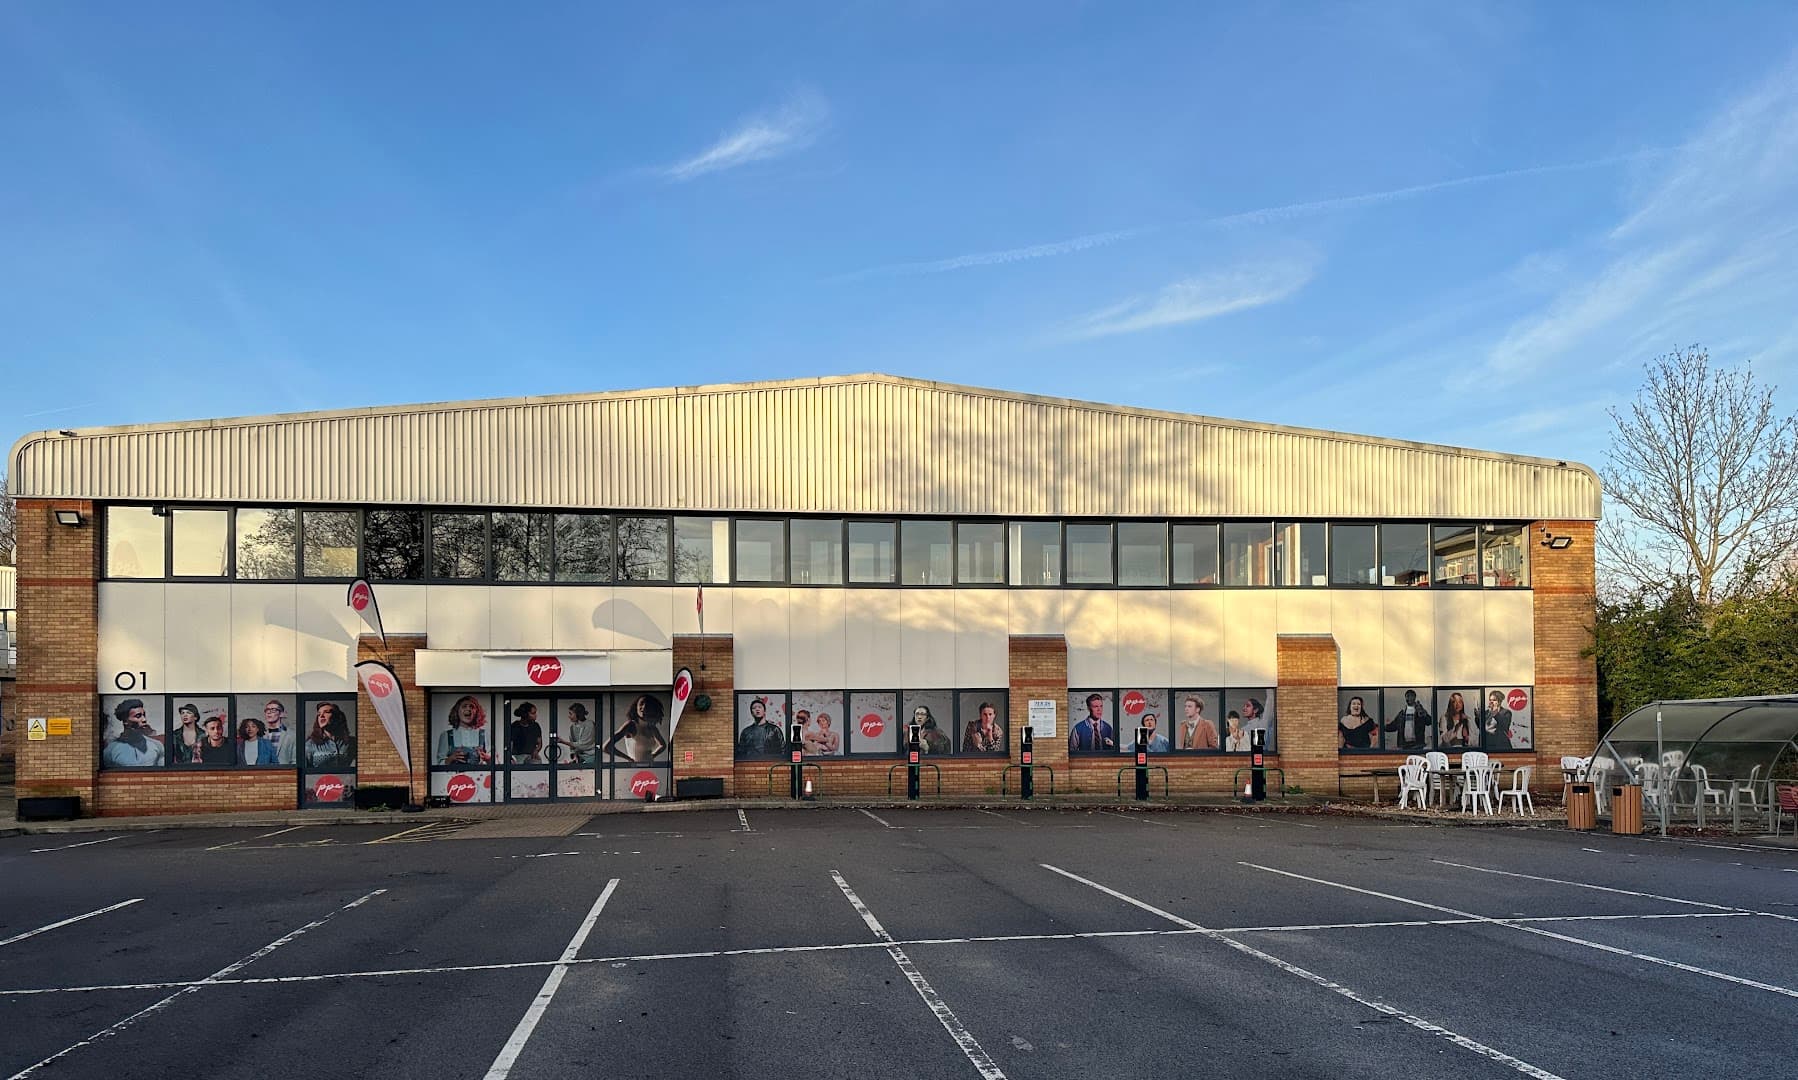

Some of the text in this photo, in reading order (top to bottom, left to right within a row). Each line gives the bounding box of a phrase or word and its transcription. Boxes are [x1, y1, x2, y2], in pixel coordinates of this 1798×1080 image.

[527, 663, 562, 679] ppa
[115, 671, 146, 690] 01
[316, 784, 345, 796] ppa
[447, 784, 477, 796] ppa
[631, 780, 659, 793] ppa
